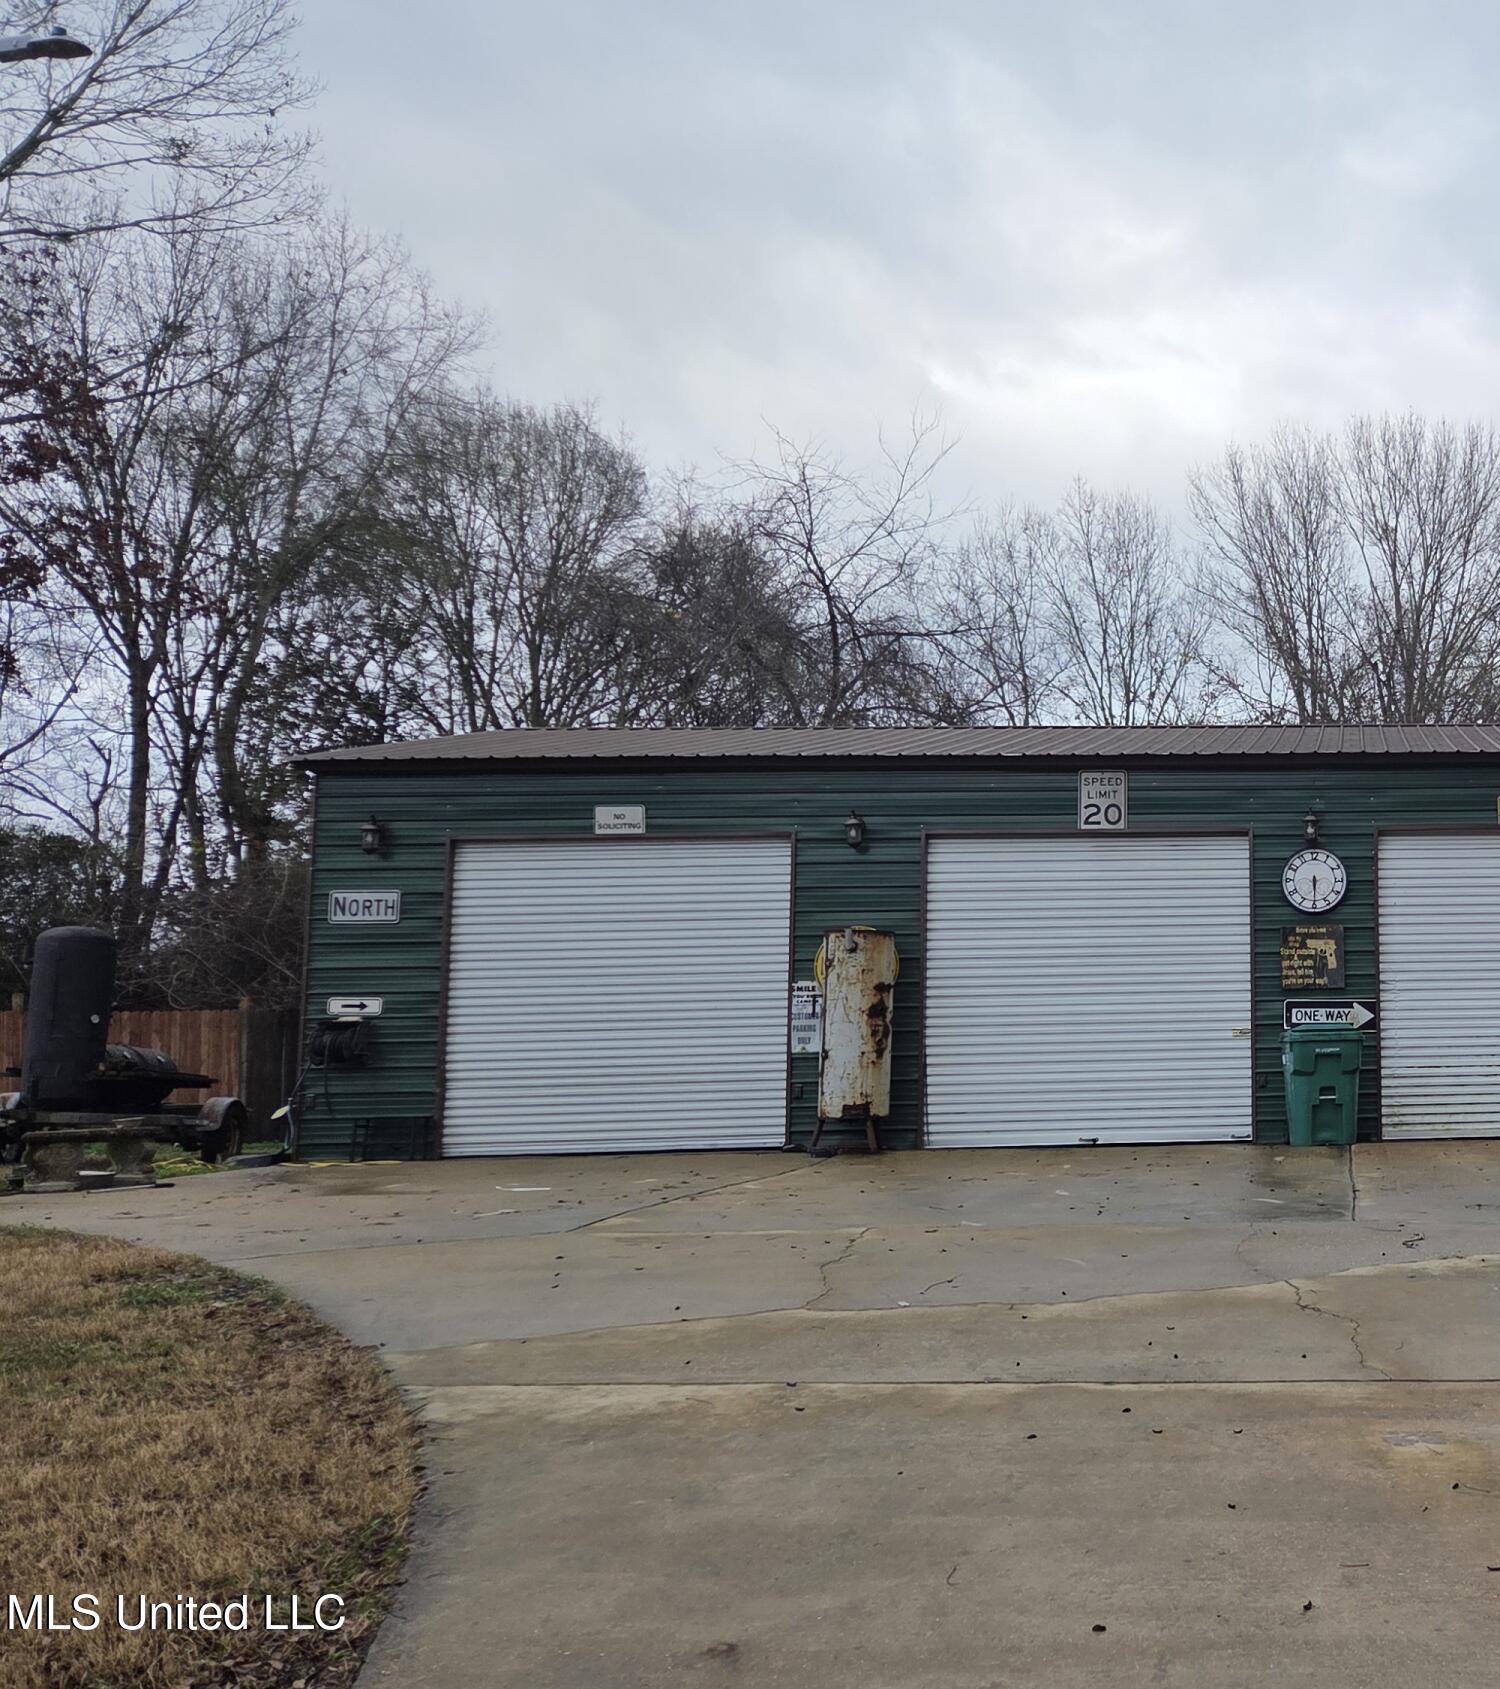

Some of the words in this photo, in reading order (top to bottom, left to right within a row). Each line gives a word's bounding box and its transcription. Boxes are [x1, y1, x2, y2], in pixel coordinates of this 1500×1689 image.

[1083, 777, 1122, 787] SPEED
[1087, 790, 1118, 800] LIMIT
[1083, 803, 1123, 826] 20
[597, 822, 642, 830] SOLICITING
[333, 896, 396, 917] NORTH
[1295, 1010, 1320, 1021] ONE
[1325, 1010, 1351, 1021] WAY
